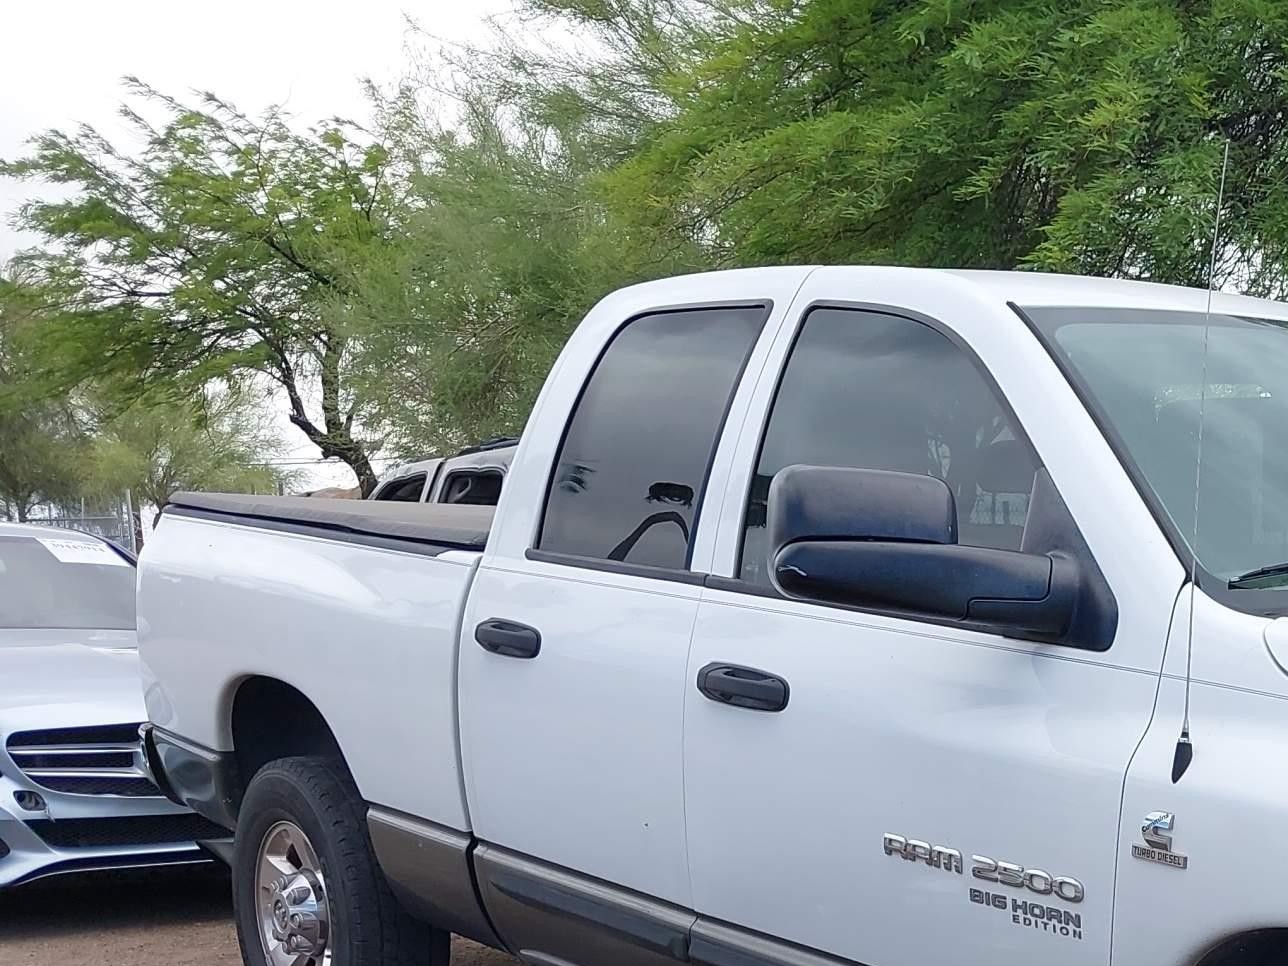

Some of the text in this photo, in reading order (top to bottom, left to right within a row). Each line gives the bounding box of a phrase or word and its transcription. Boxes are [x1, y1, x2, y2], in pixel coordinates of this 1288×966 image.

[883, 832, 1085, 904] RAM 2500
[1134, 846, 1182, 866] TURBO DIESEL
[969, 887, 1082, 929] BIG HORN
[1011, 914, 1083, 940] EDITION
